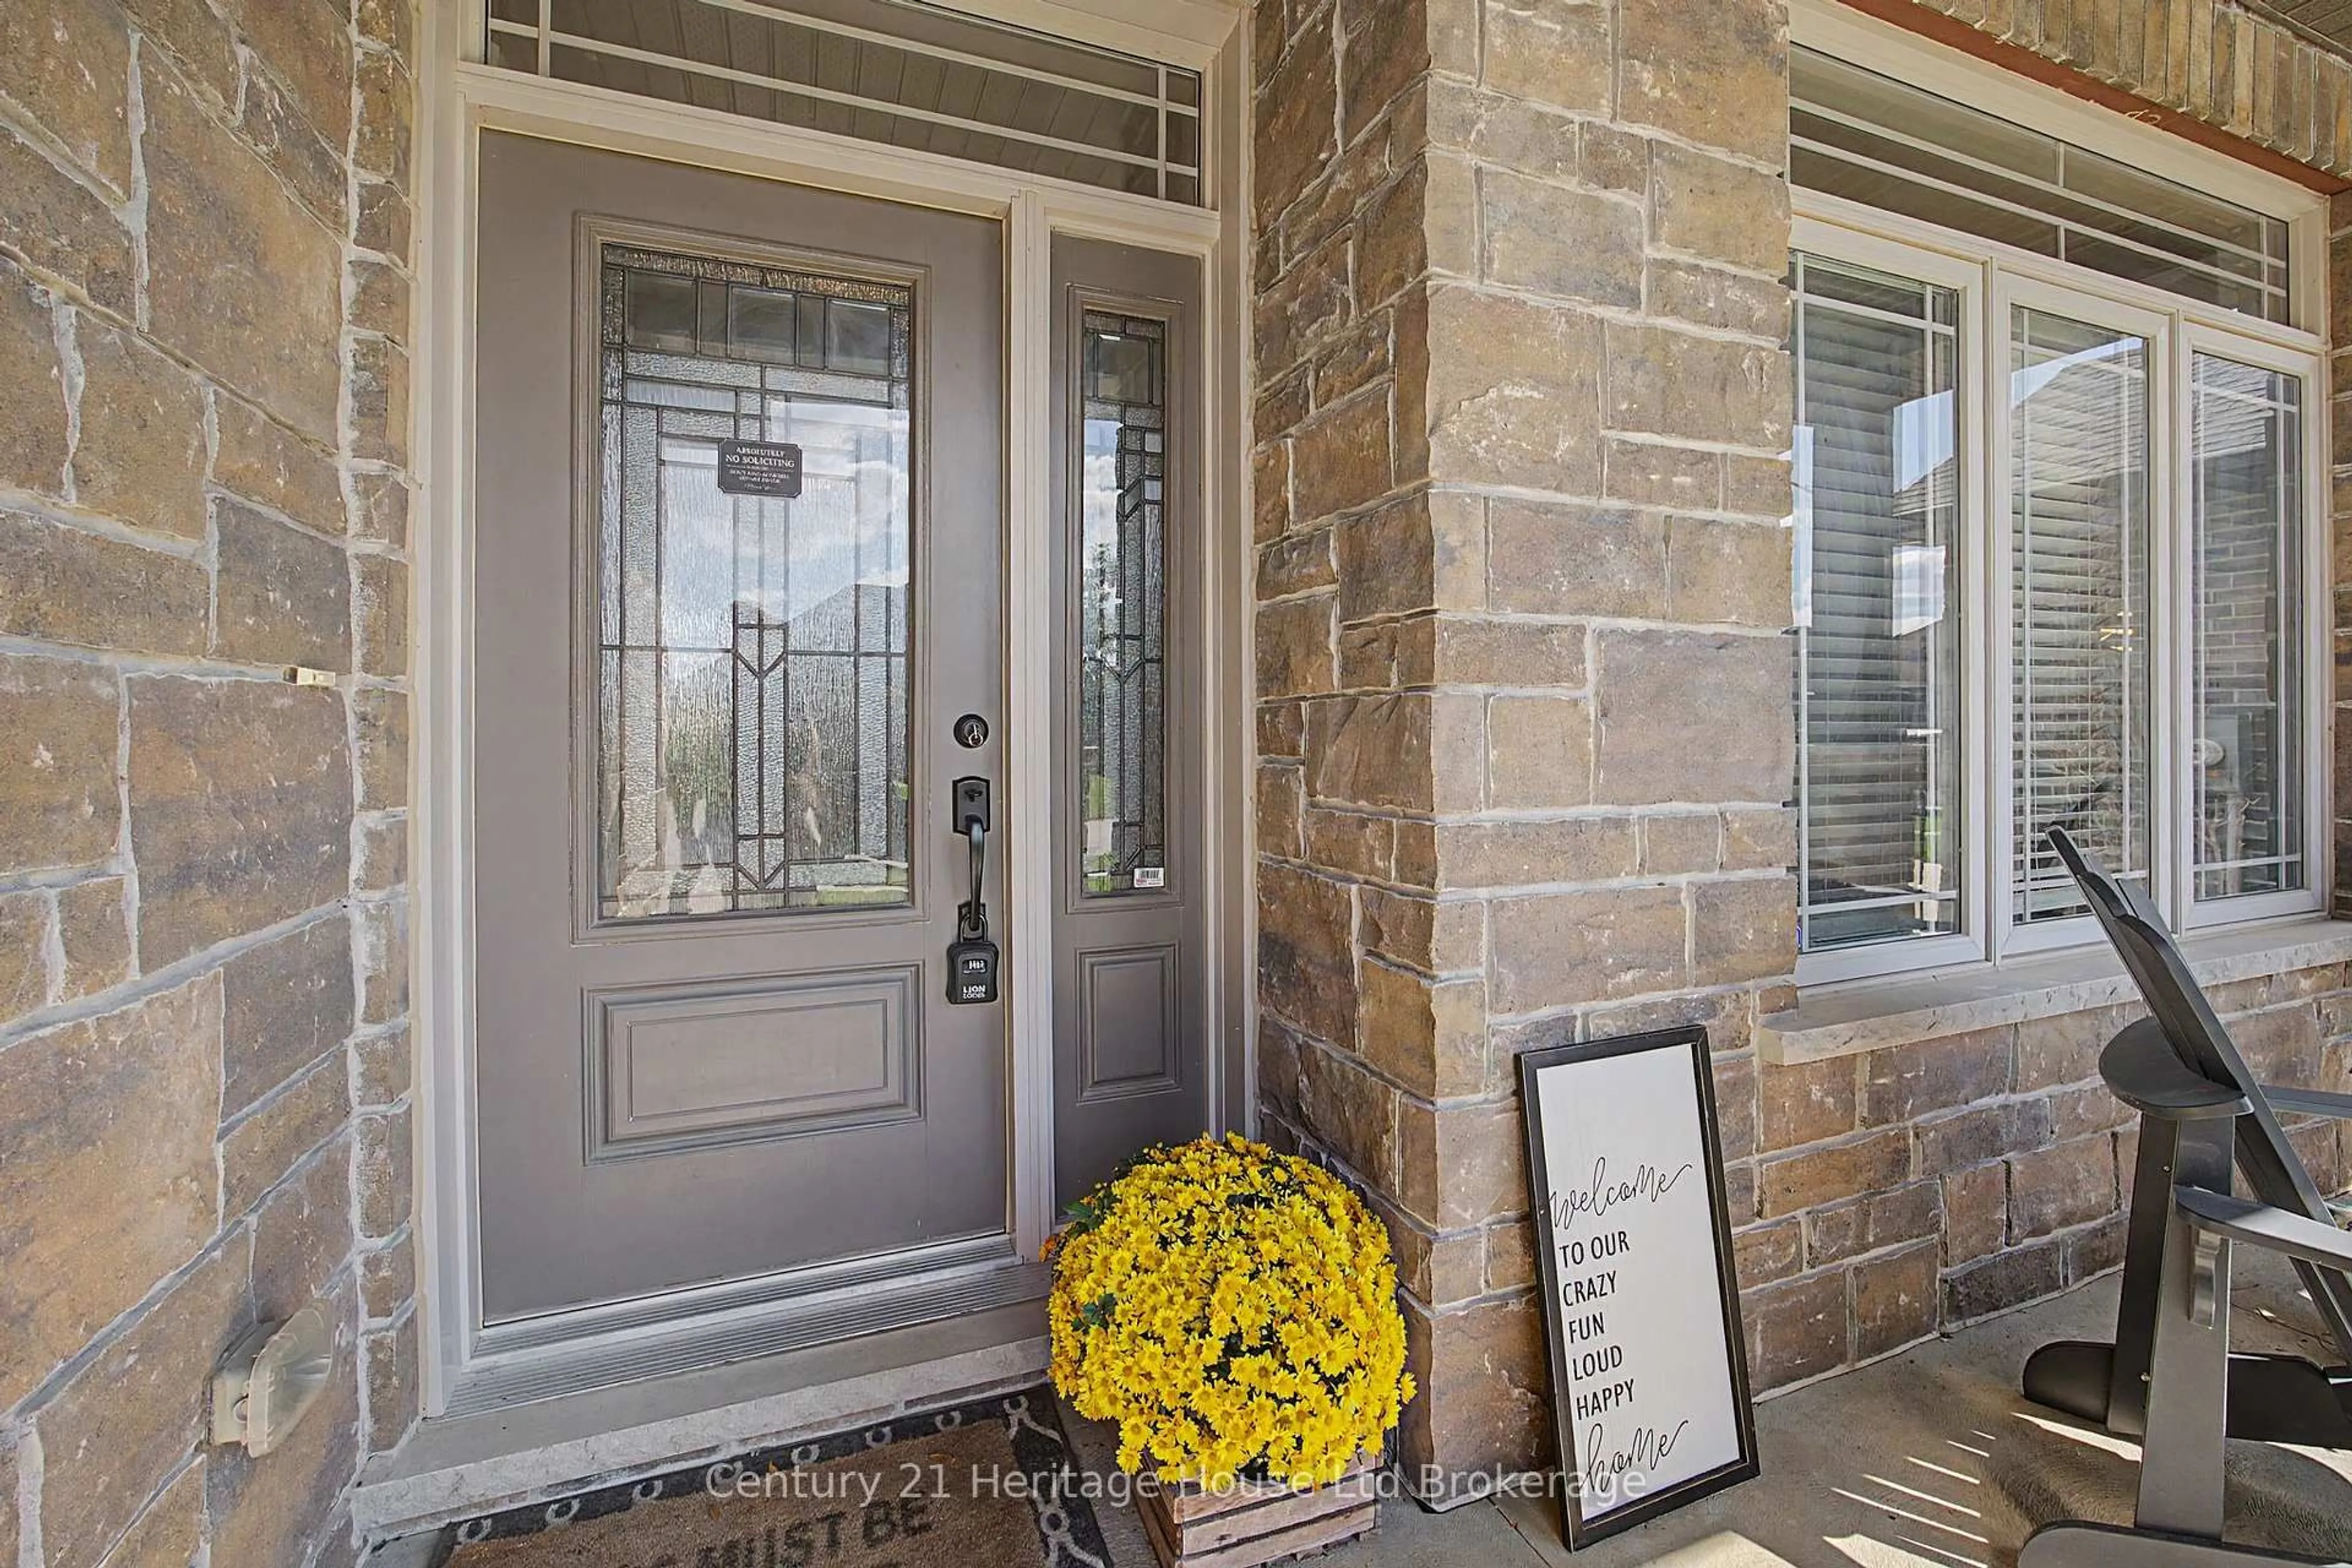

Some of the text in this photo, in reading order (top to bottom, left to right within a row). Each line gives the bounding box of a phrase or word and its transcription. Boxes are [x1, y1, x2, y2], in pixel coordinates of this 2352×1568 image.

[725, 454, 795, 467] NO SOLICITING
[962, 984, 986, 993] LION
[1549, 1156, 1693, 1230] welcome
[1559, 1231, 1630, 1268] TO OUR
[1562, 1270, 1617, 1307] CRAZY
[1568, 1311, 1605, 1344] FUN
[1572, 1345, 1623, 1382] LOUD
[1576, 1378, 1635, 1421] HAPPY
[1578, 1420, 1689, 1493] home
[862, 1497, 933, 1549] BE
